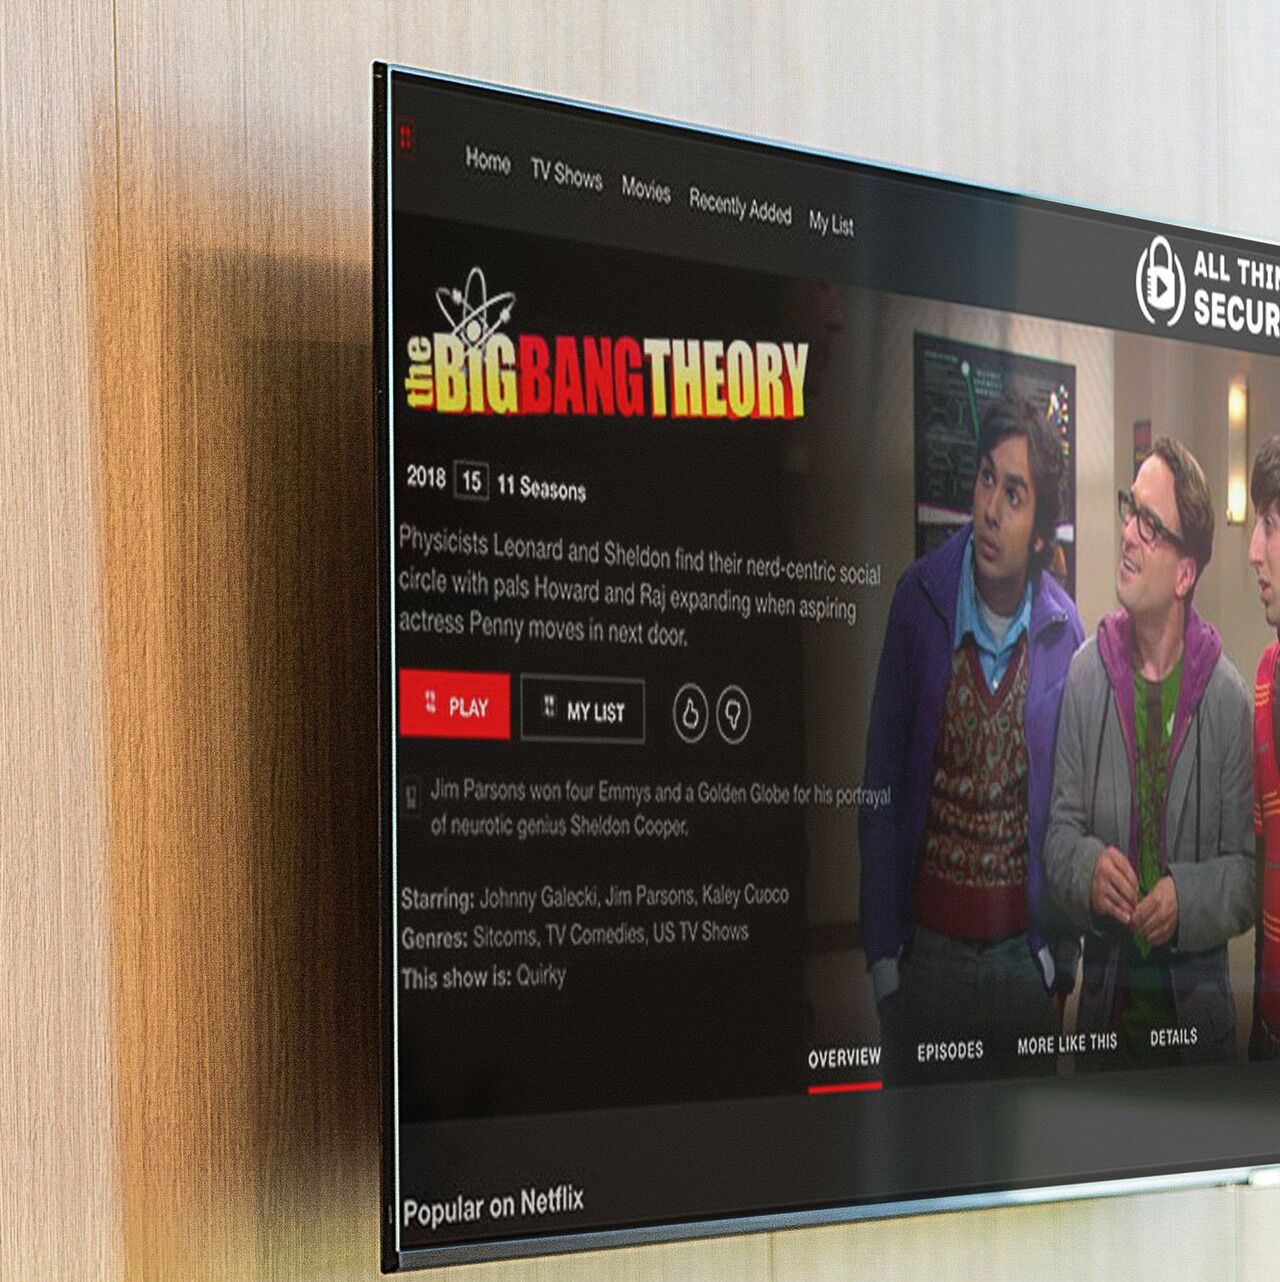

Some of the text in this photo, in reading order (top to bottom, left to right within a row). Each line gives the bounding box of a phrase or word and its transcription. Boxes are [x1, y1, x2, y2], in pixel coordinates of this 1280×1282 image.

[465, 146, 512, 175] Home
[531, 158, 603, 191] TV Shows
[622, 176, 671, 204] Movies
[690, 188, 792, 225] Recently Added
[809, 210, 854, 237] My List
[1194, 251, 1230, 282] ALL
[405, 336, 434, 409] the
[434, 332, 809, 419] BIG BANG THEORY
[407, 465, 447, 489] 2018
[462, 471, 481, 491] 15
[498, 474, 587, 502] 11 Seasons
[399, 524, 881, 584] Physicists Leonard and Sheldon find their nerd-centric social
[399, 570, 857, 625] circle with pals Howard and Raj expanding when aspiring
[399, 608, 688, 646] actress Penny moves in next door.
[450, 697, 488, 717] PLAY
[567, 703, 590, 722] MY
[594, 703, 624, 723] LIST
[431, 778, 459, 801] Jim
[463, 779, 525, 800] Parsons
[530, 785, 562, 801] won
[566, 779, 594, 801] four
[599, 782, 651, 807] Emmys
[655, 782, 681, 802] and
[686, 788, 694, 803] a
[698, 782, 747, 804] Golden
[750, 783, 790, 804] Globe
[793, 784, 811, 804] for
[814, 785, 832, 804] his
[836, 784, 891, 810] portrayal
[431, 813, 689, 841] of neurotic genius Sheldon Cooper.
[401, 884, 789, 913] Starring: Johnny Galecki, Jim Parsons, Kaley Cuoco
[401, 921, 749, 949] Genres: Sitcoms, TV Comedies, US TV Shows
[402, 963, 566, 990] This show is: Quirky
[917, 1040, 984, 1062] EPISODES
[1018, 1033, 1117, 1055] MORE LIKE THIS
[1150, 1028, 1198, 1047] DETAILS
[808, 1046, 881, 1069] OVERVIEW
[404, 1185, 584, 1232] Popular on Netflix
